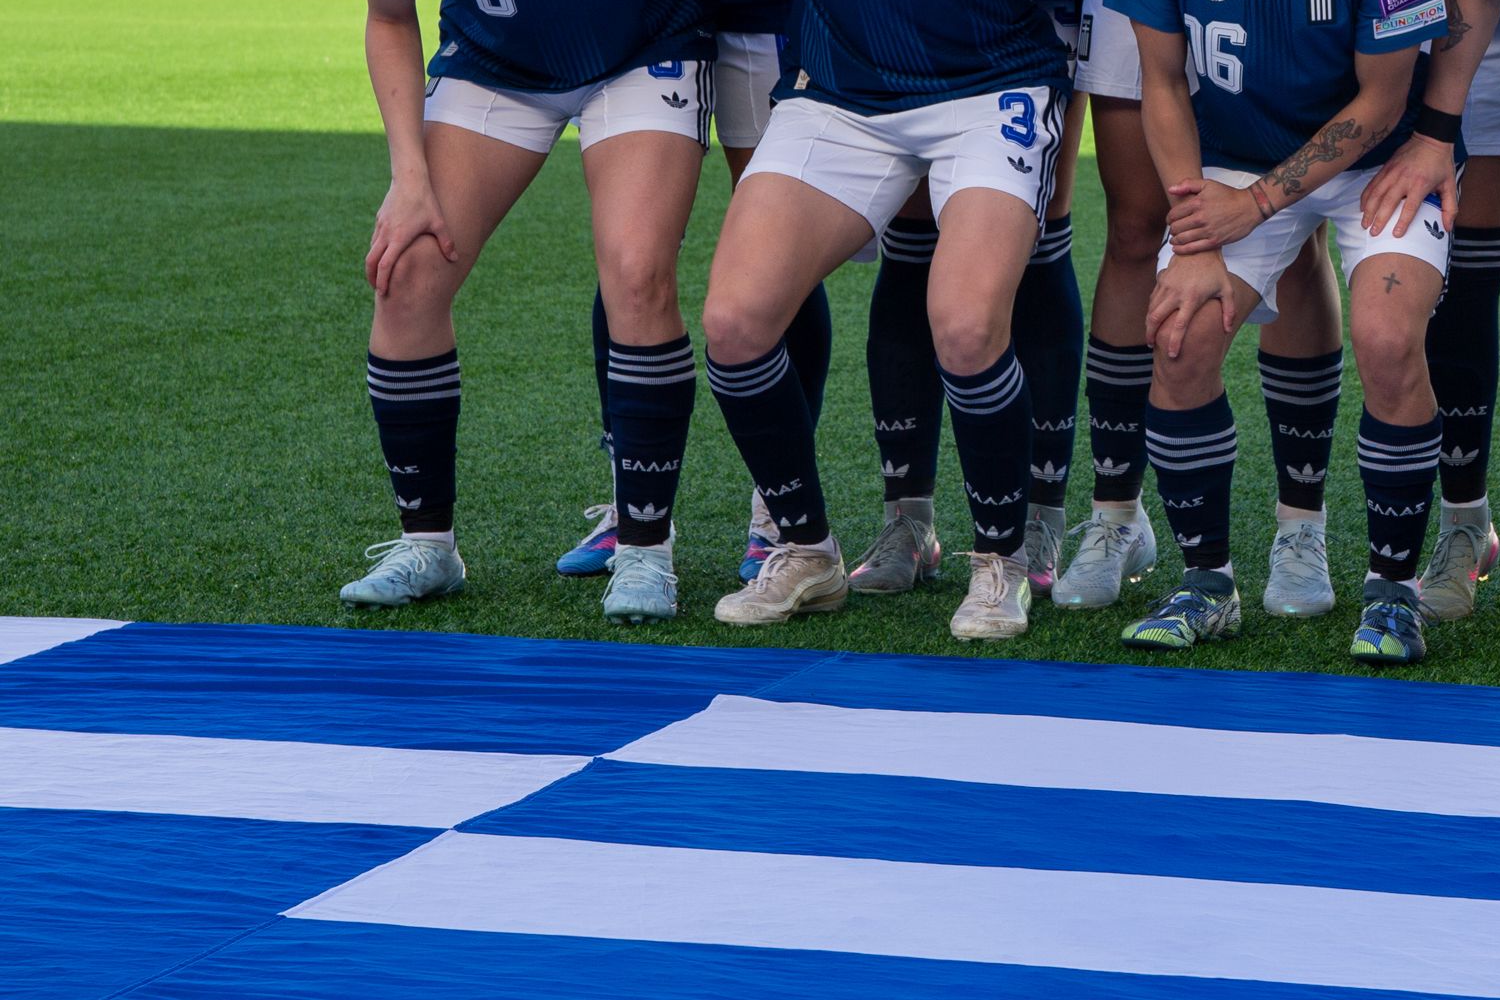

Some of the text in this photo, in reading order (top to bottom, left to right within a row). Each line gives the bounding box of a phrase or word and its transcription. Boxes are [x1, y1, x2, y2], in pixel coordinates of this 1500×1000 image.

[1183, 13, 1247, 95] 16
[998, 91, 1038, 149] 3
[1439, 405, 1488, 417] ΛΛΑΣ
[875, 417, 917, 432] ΛΛΑΣ
[1032, 415, 1075, 432] ΛΛΑΣ
[622, 458, 680, 472] ΕΛΛΑΣ
[757, 478, 803, 497] ΛΛΑΣ
[1367, 499, 1426, 517] ΕΛΛΑΣ
